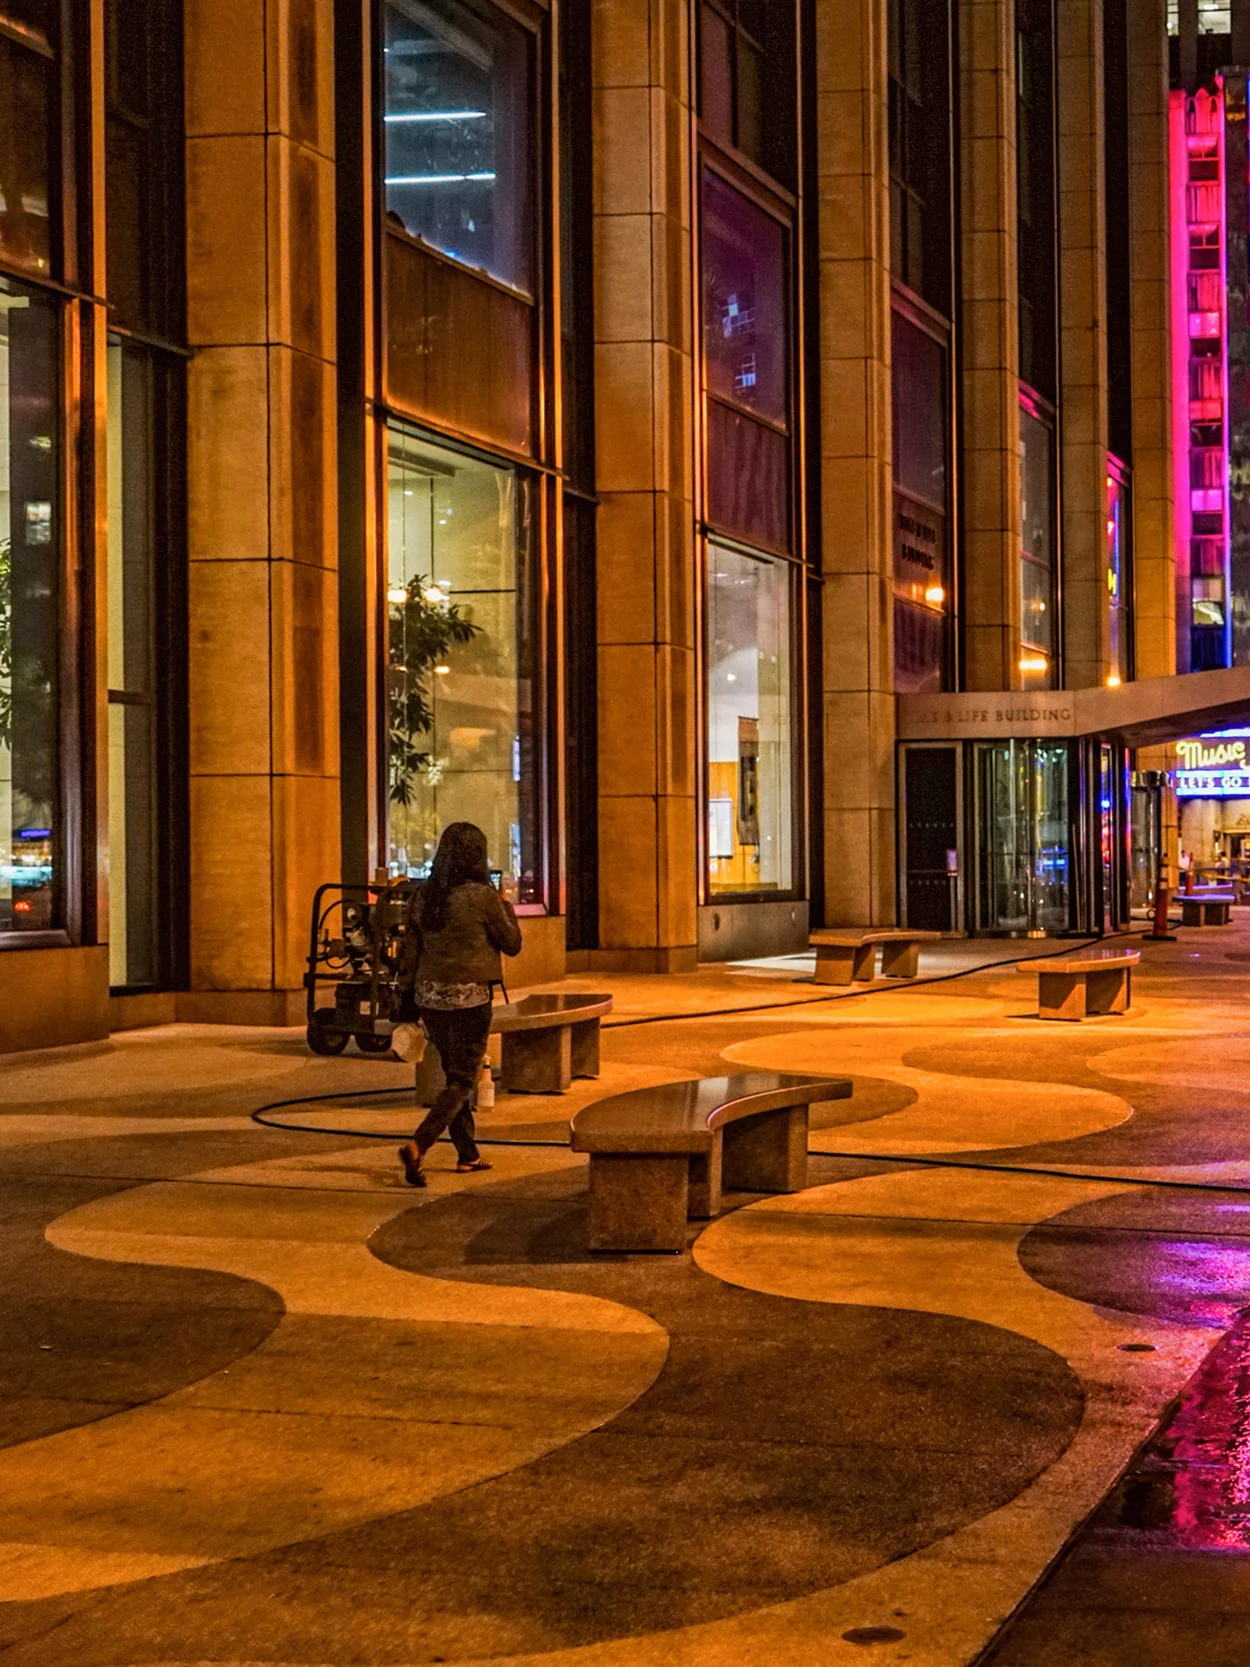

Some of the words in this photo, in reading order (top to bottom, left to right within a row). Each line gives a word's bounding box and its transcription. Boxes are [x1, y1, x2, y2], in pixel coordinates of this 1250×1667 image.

[995, 708, 1072, 721] BUILDING
[1176, 741, 1246, 770] Music
[1180, 776, 1215, 788] LET'S
[1221, 776, 1242, 787] GO
